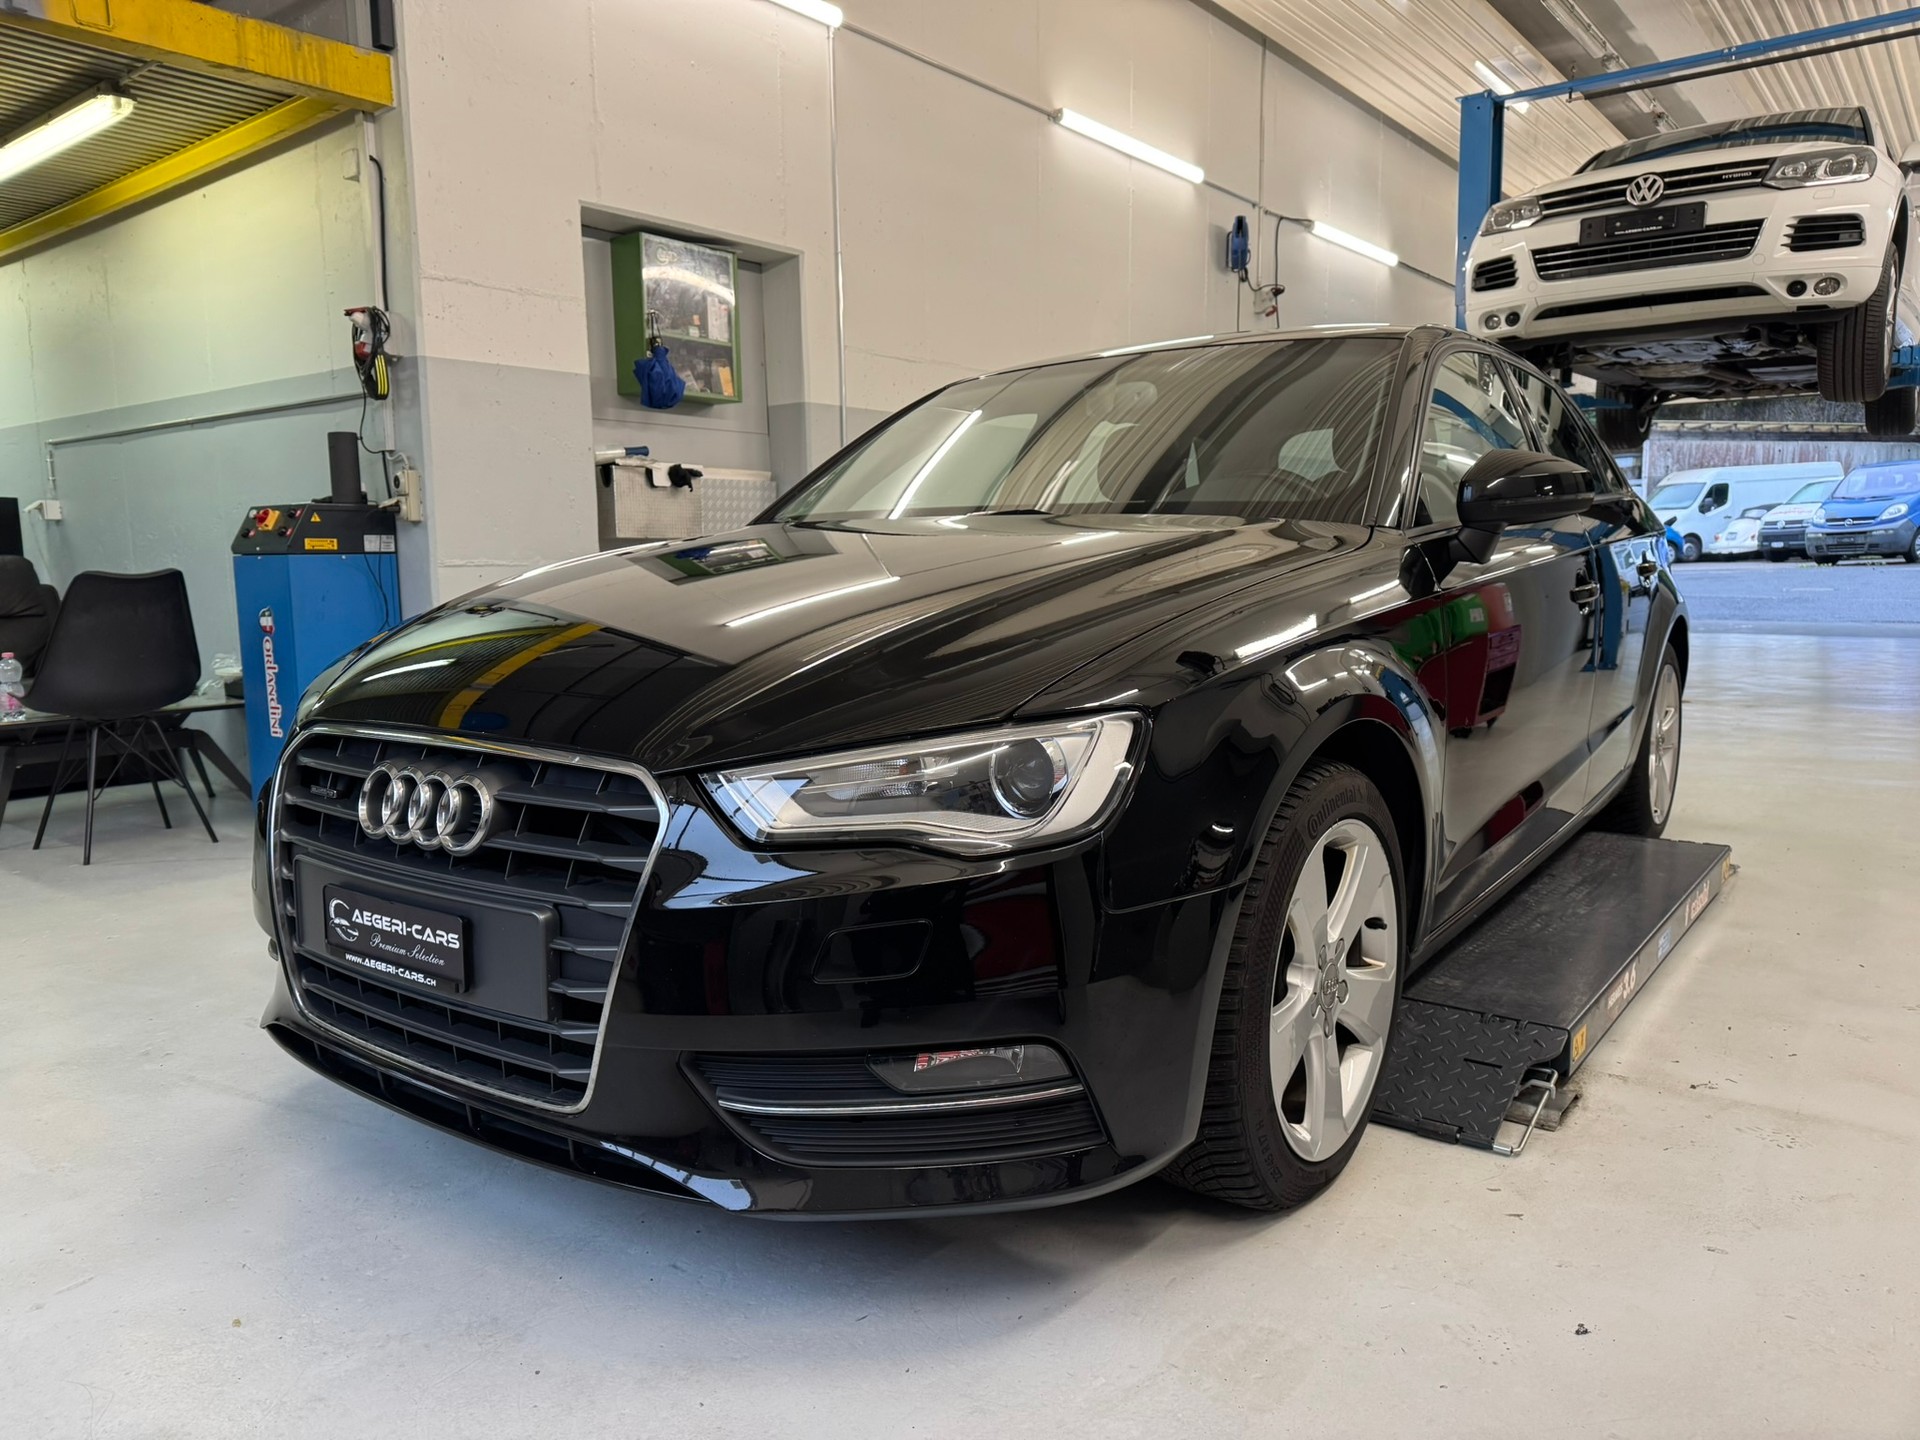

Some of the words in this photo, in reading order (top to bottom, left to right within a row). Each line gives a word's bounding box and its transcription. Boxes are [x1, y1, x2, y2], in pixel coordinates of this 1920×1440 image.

[1308, 786, 1357, 839] Continental
[351, 908, 460, 949] AEGERI-CARS
[370, 933, 407, 956] Premium
[407, 944, 446, 966] Selection
